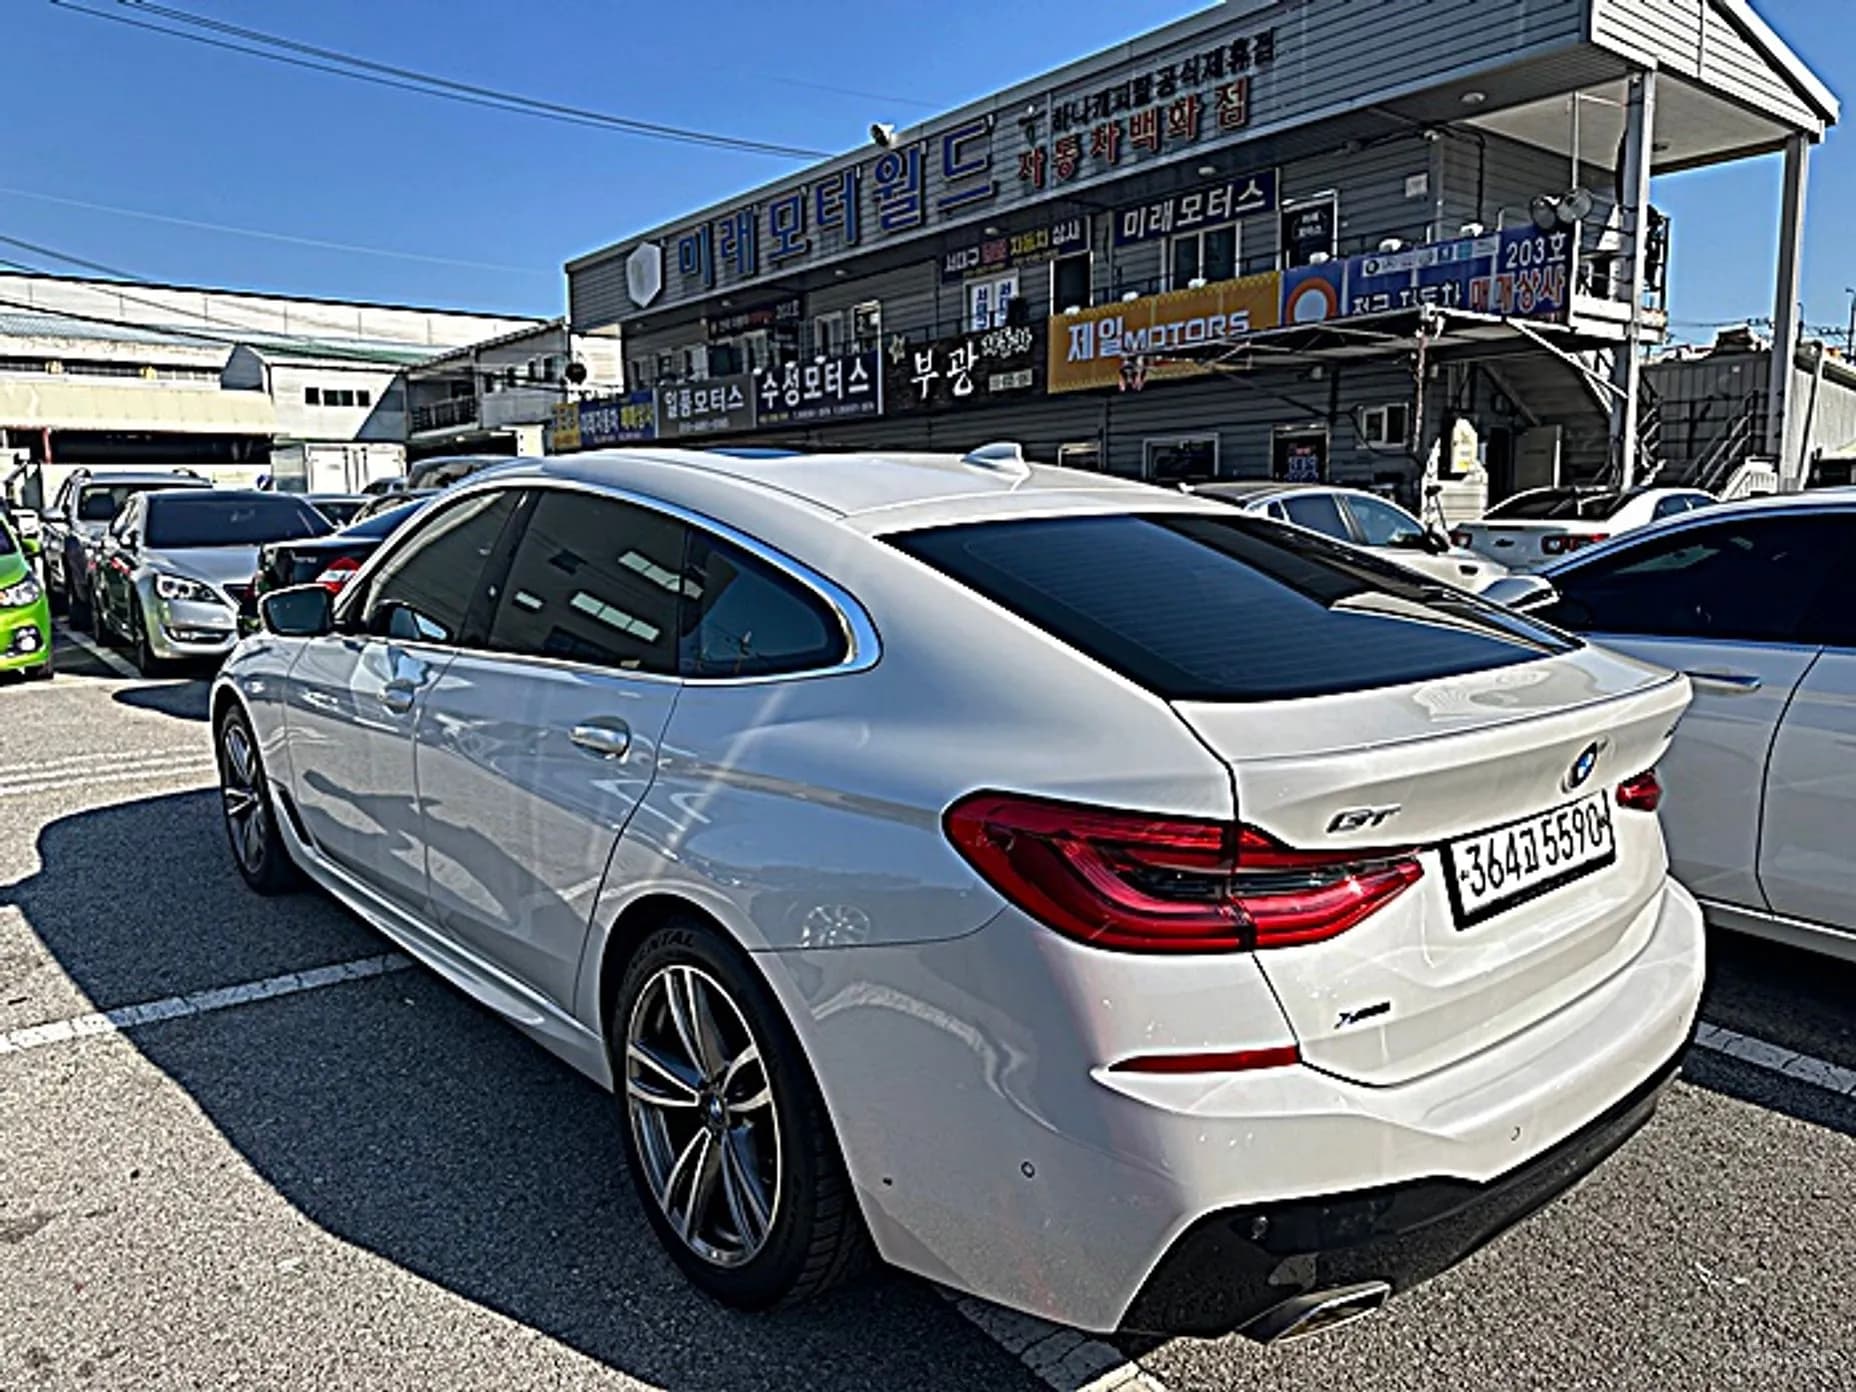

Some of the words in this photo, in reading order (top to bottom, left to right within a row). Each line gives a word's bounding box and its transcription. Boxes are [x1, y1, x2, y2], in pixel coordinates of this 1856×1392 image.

[678, 117, 997, 287] 미래모터월드
[1123, 179, 1266, 238] 미래모터스
[1506, 231, 1567, 269] 203호
[761, 358, 870, 410] 수성모터스
[910, 340, 979, 399] 부광
